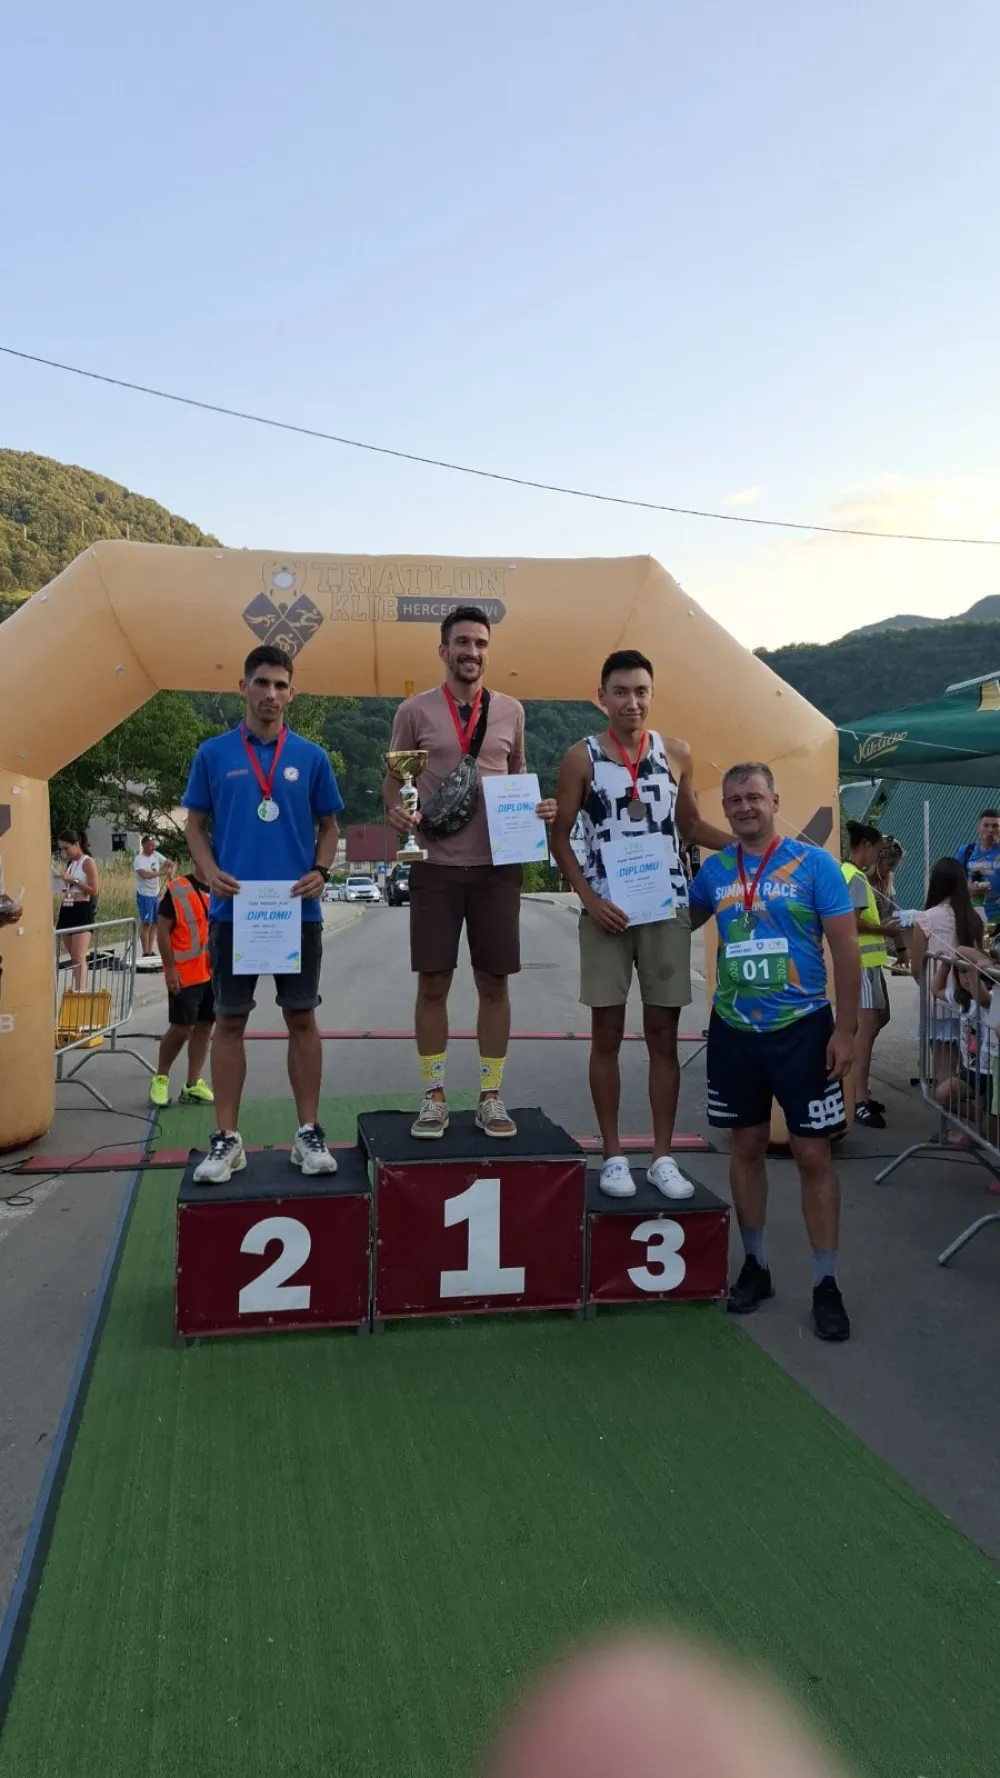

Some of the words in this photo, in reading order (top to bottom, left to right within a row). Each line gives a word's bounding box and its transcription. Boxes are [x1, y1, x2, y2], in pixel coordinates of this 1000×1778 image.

[311, 562, 506, 597] TRIATLON
[330, 587, 398, 621] KLUB
[498, 802, 534, 813] DIPLOMU
[619, 861, 660, 877] DIPLOMU
[763, 882, 797, 898] RACE
[247, 910, 292, 920] DIPLOMU
[743, 958, 769, 980] 01
[439, 1178, 525, 1298] 1
[238, 1216, 312, 1314] 2
[626, 1218, 687, 1292] 3
